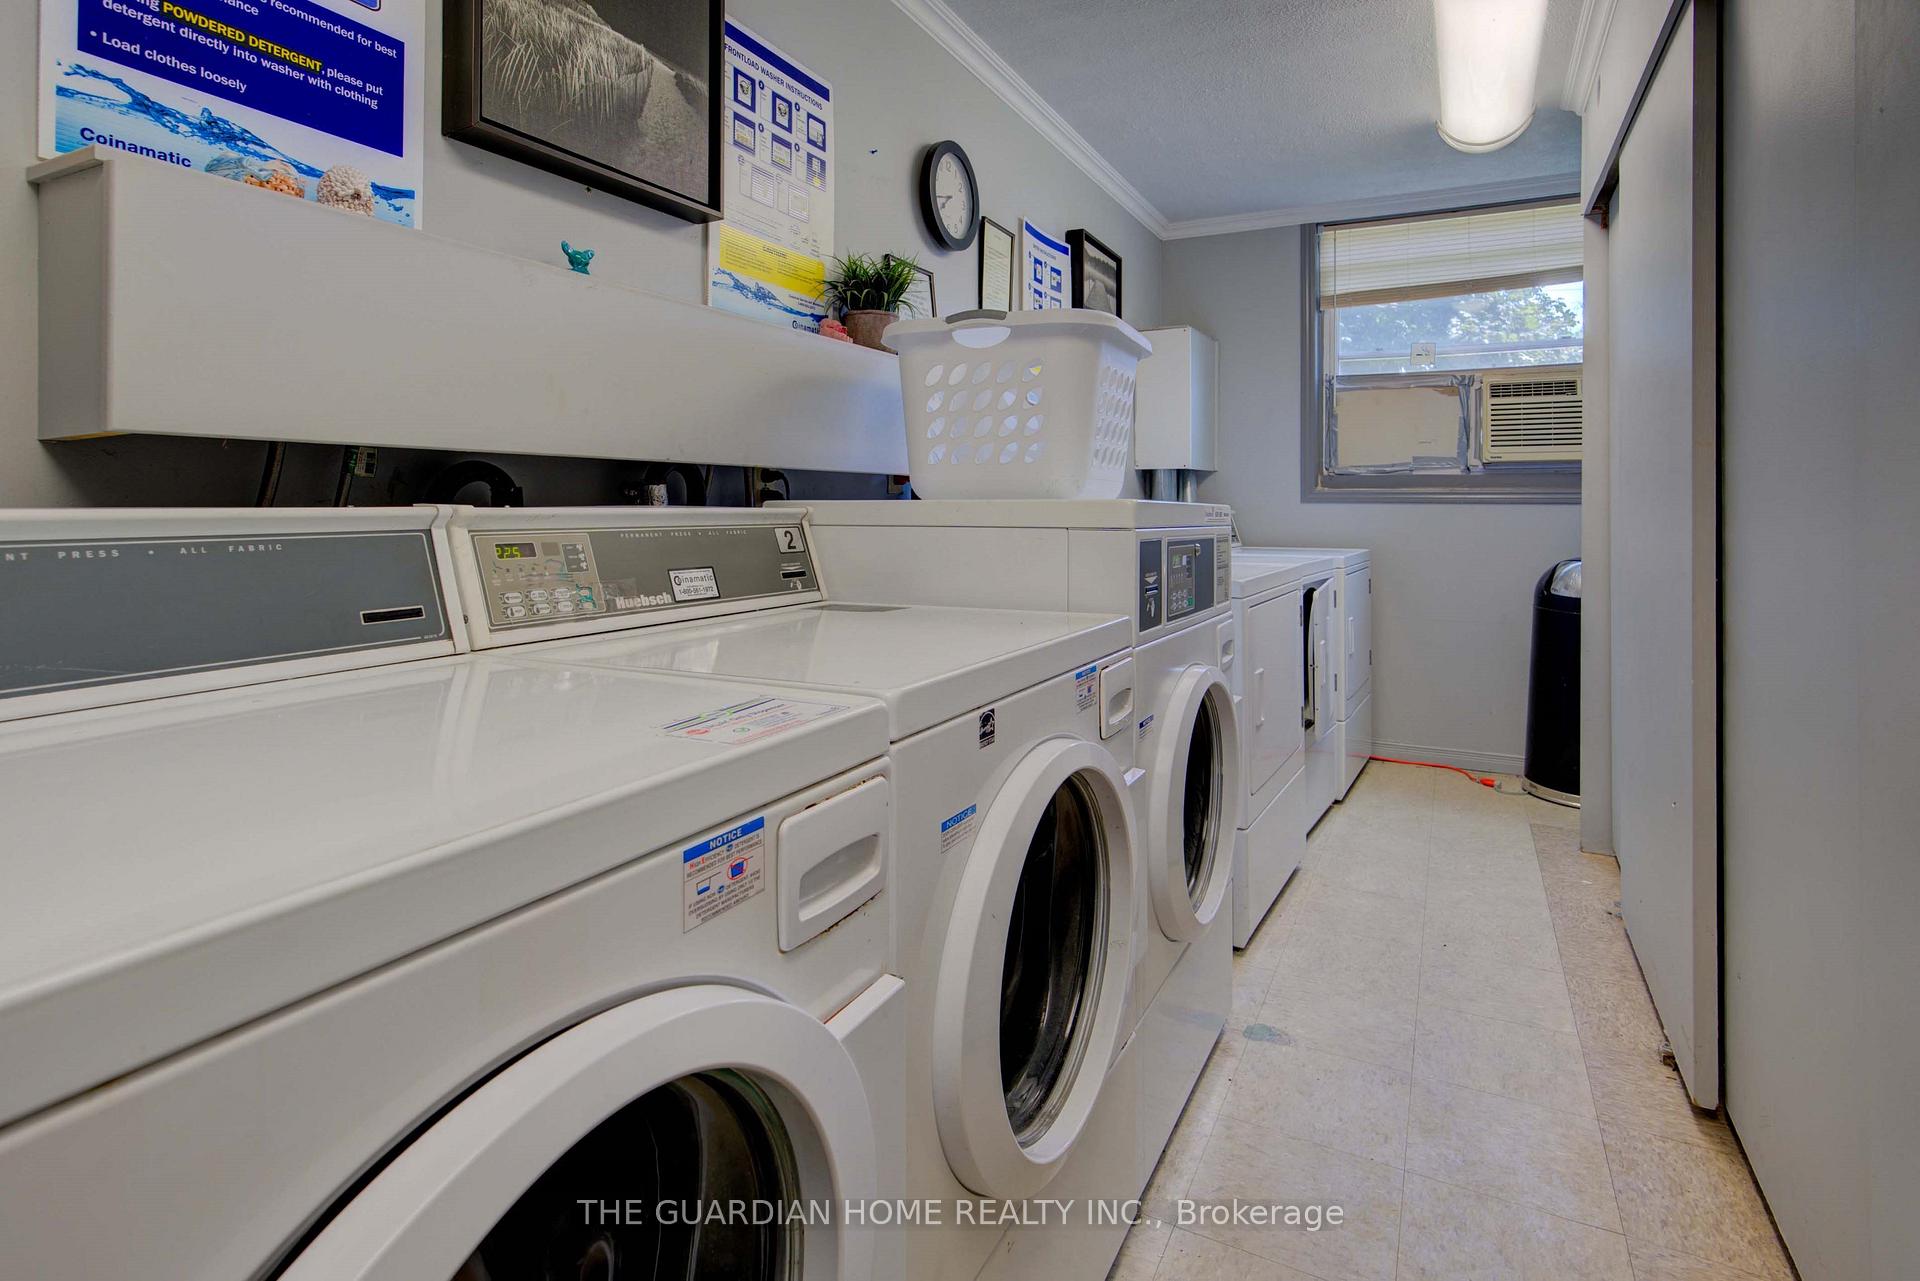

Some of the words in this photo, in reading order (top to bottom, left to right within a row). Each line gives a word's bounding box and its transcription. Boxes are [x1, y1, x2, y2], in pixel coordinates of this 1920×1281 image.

[163, 2, 246, 42] POWDERED
[248, 34, 325, 75] DETERGENT,
[326, 68, 363, 88] please
[365, 82, 384, 97] put
[270, 0, 354, 40] recommended
[357, 33, 373, 48] for
[374, 41, 398, 59] best
[102, 0, 176, 34] detergent
[179, 26, 230, 55] directly
[233, 45, 258, 64] into
[260, 57, 305, 81] washer
[307, 74, 332, 92] with
[334, 85, 379, 110] clothing
[102, 32, 141, 56] Load
[144, 49, 197, 75] clothes
[200, 66, 248, 93] loosely
[760, 65, 785, 87] WASHER
[785, 81, 823, 111] INSTRUCTIONS
[80, 127, 192, 168] Coinamatic
[57, 549, 120, 560] PRESS
[180, 547, 208, 555] ALL
[228, 543, 283, 553] FABRIC
[784, 530, 797, 550] 2
[673, 574, 714, 586] Coinamatic
[615, 592, 673, 610] Huebsch
[709, 828, 743, 850] NOTICE
